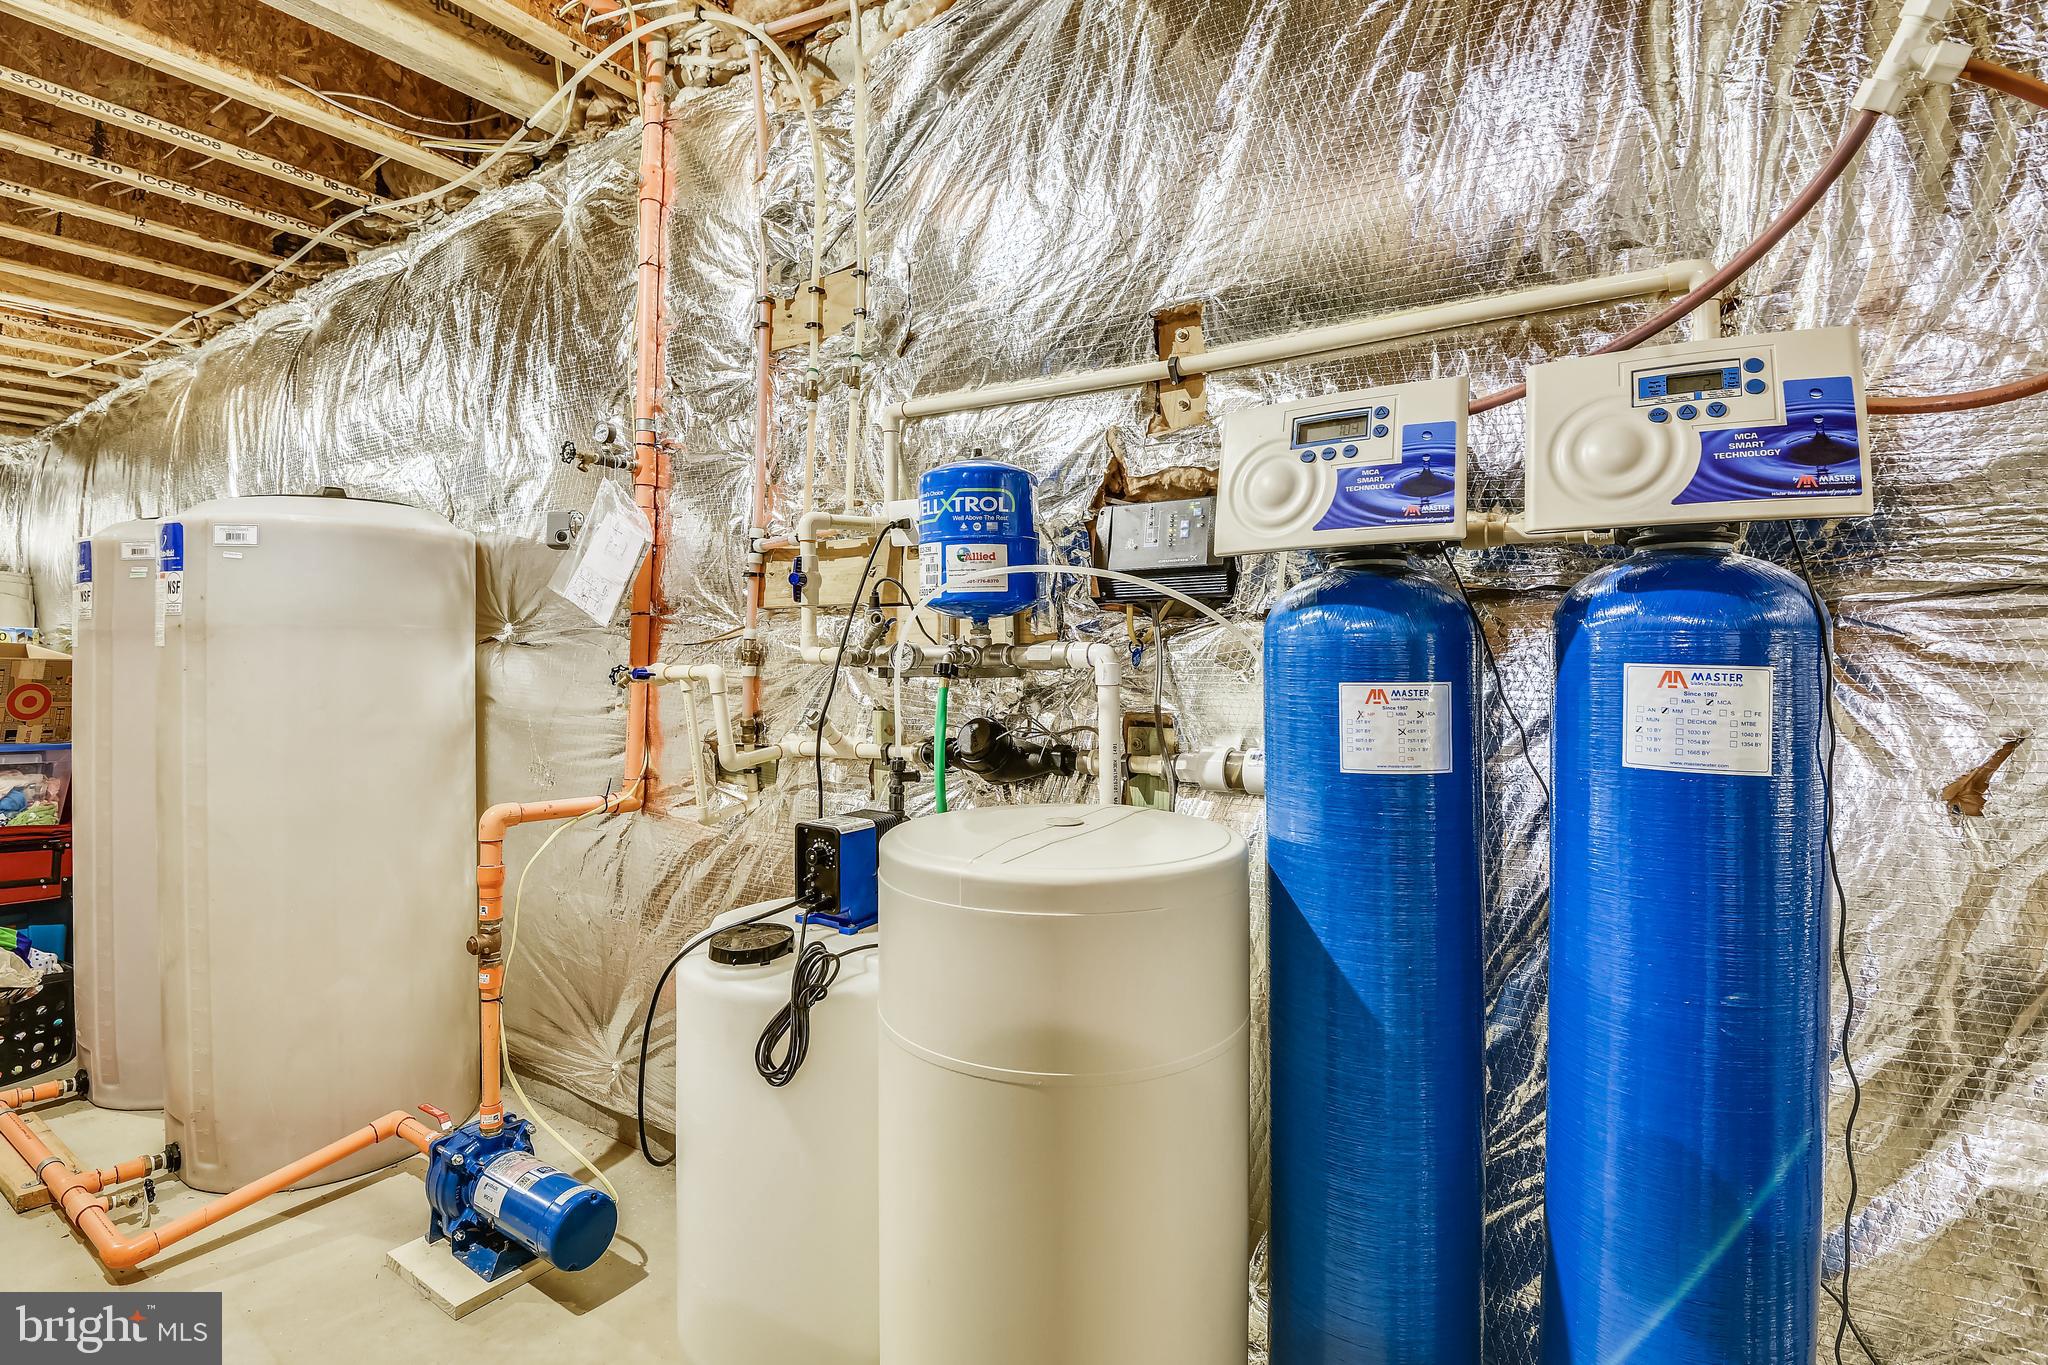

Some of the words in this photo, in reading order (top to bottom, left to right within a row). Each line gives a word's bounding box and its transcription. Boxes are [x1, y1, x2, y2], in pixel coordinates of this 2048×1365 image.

[599, 60, 631, 83] 210
[11, 72, 128, 119] SOURCING
[132, 113, 223, 151] SFI-00008
[51, 145, 83, 163] TJI
[87, 158, 124, 176] 210
[323, 179, 382, 206] 08-03-16
[1734, 432, 1759, 440] MCA
[1728, 441, 1765, 450] SMART
[1713, 448, 1781, 461] TECHNOLOGY
[1356, 476, 1384, 484] SMART
[1818, 474, 1856, 482] MASTER
[1345, 482, 1396, 493] TECHNOLOGY
[920, 496, 1009, 517] ELLXTROL
[964, 551, 997, 561] Allied
[167, 579, 181, 595] NSF
[80, 589, 92, 603] NSF
[1691, 672, 1744, 682] MASTER
[1391, 689, 1430, 697] MASTER
[1687, 718, 1718, 726] DECHLOR
[1669, 761, 1730, 769] www.masterwater.com
